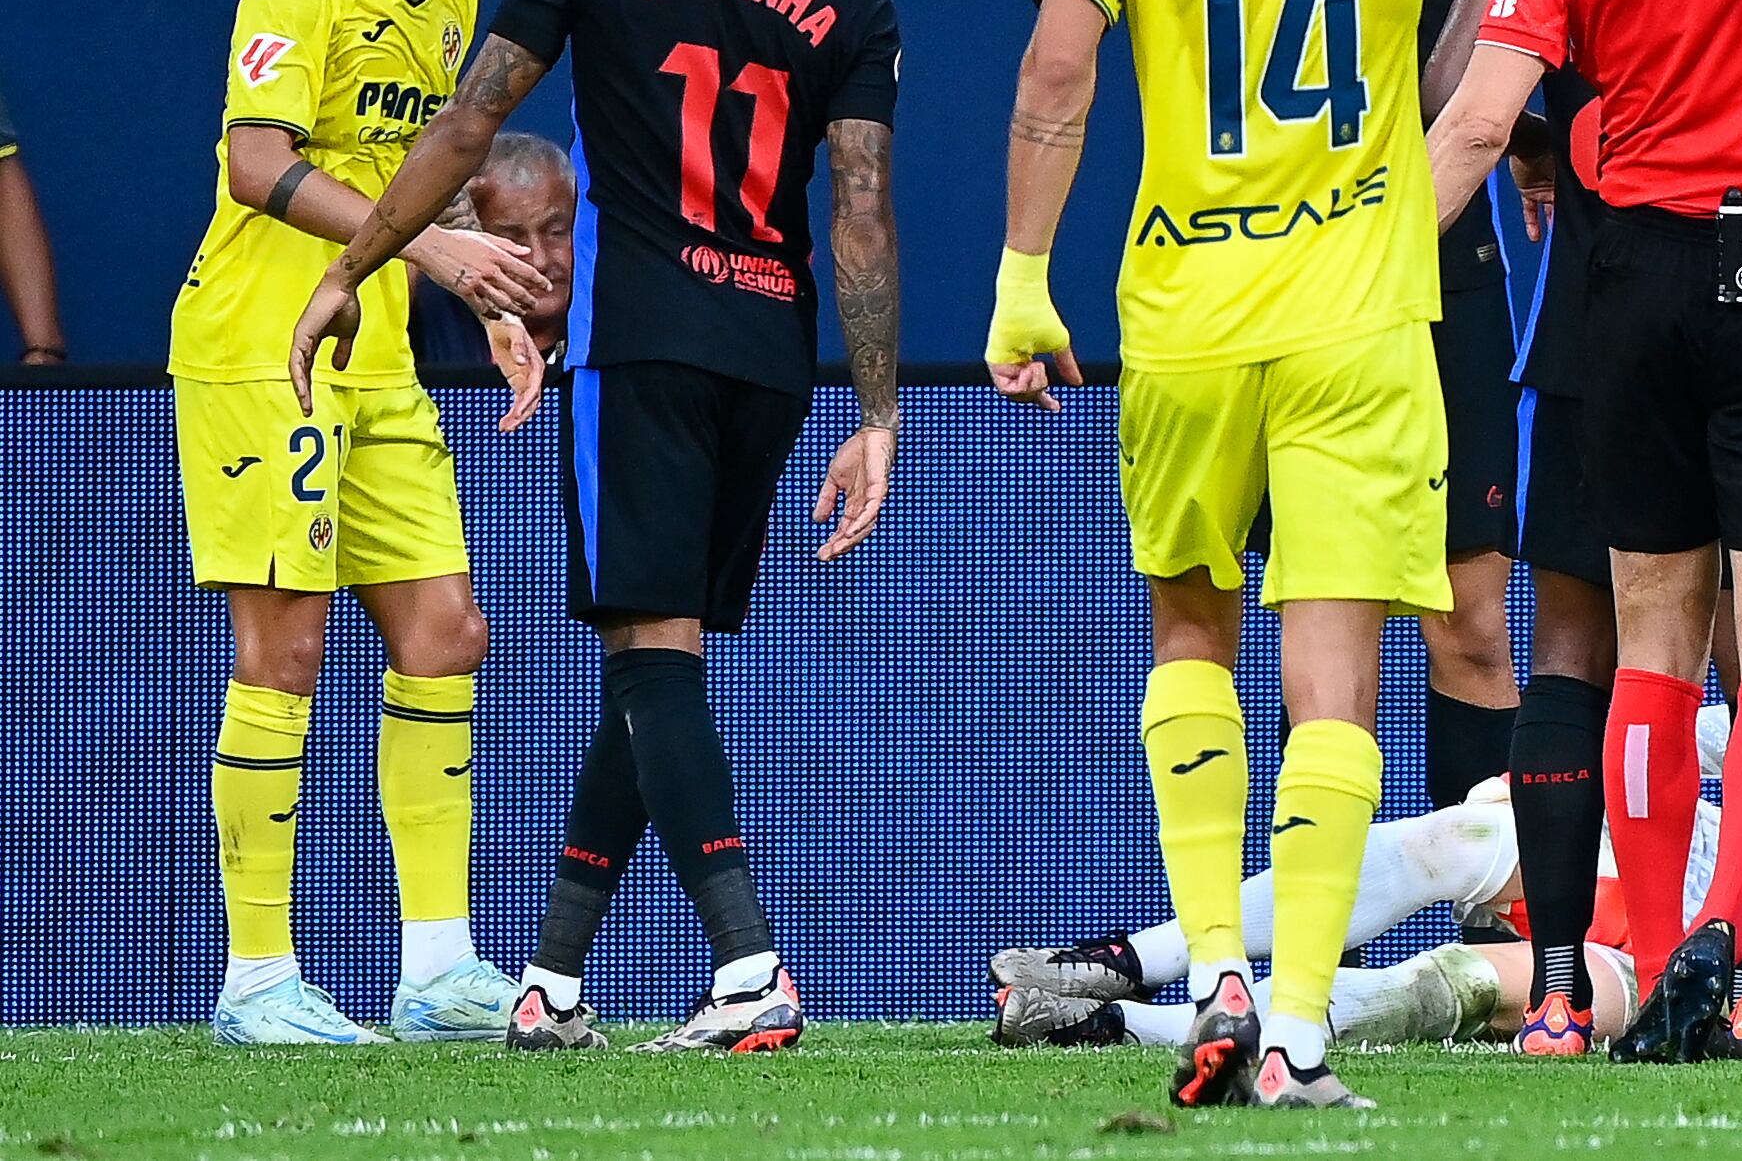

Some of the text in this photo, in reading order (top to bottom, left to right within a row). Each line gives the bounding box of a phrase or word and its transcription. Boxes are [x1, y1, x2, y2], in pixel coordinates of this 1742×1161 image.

[658, 41, 790, 243] 11
[1134, 166, 1388, 247] ASCALE
[733, 270, 797, 296] ACNUR
